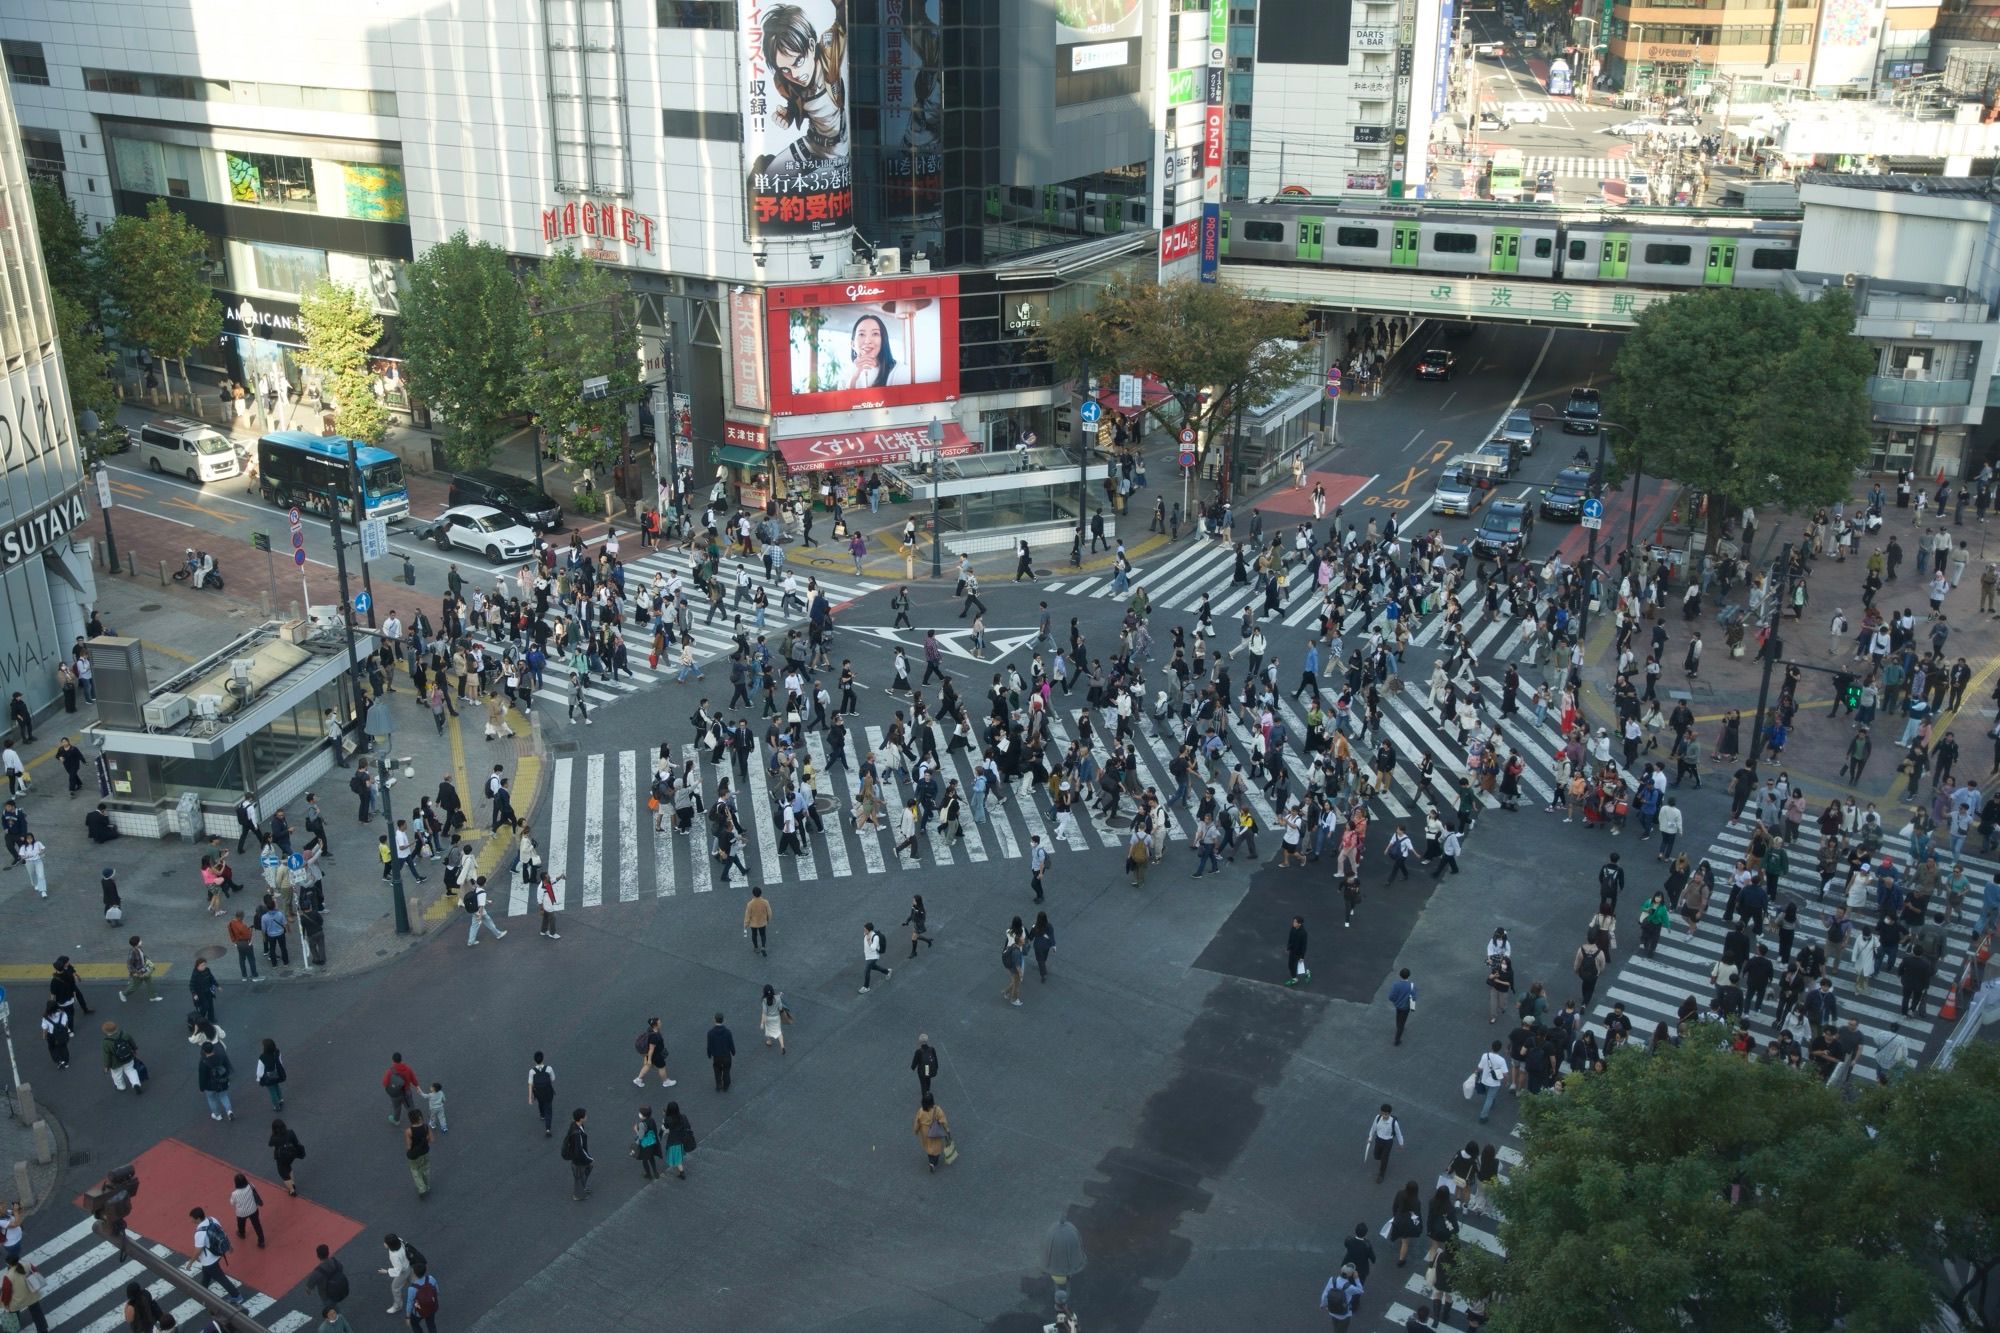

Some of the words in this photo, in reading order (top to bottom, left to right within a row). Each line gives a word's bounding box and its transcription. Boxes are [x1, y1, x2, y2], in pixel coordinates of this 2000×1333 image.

[1356, 30, 1384, 39] DARTS
[1366, 38, 1384, 46] BAR
[1208, 128, 1220, 159] アコム
[542, 200, 656, 252] MAGNET
[1165, 230, 1188, 255] アコム
[1205, 216, 1216, 261] PROMISE
[846, 285, 884, 301] Glico
[1430, 285, 1452, 299] JR
[1009, 320, 1041, 329] COFFEE
[737, 310, 758, 406] 天津甘栗
[727, 427, 765, 444] 天津甘栗
[809, 437, 865, 457] くすり
[791, 462, 825, 472] SANZENRI
[1362, 496, 1411, 509] 8-20
